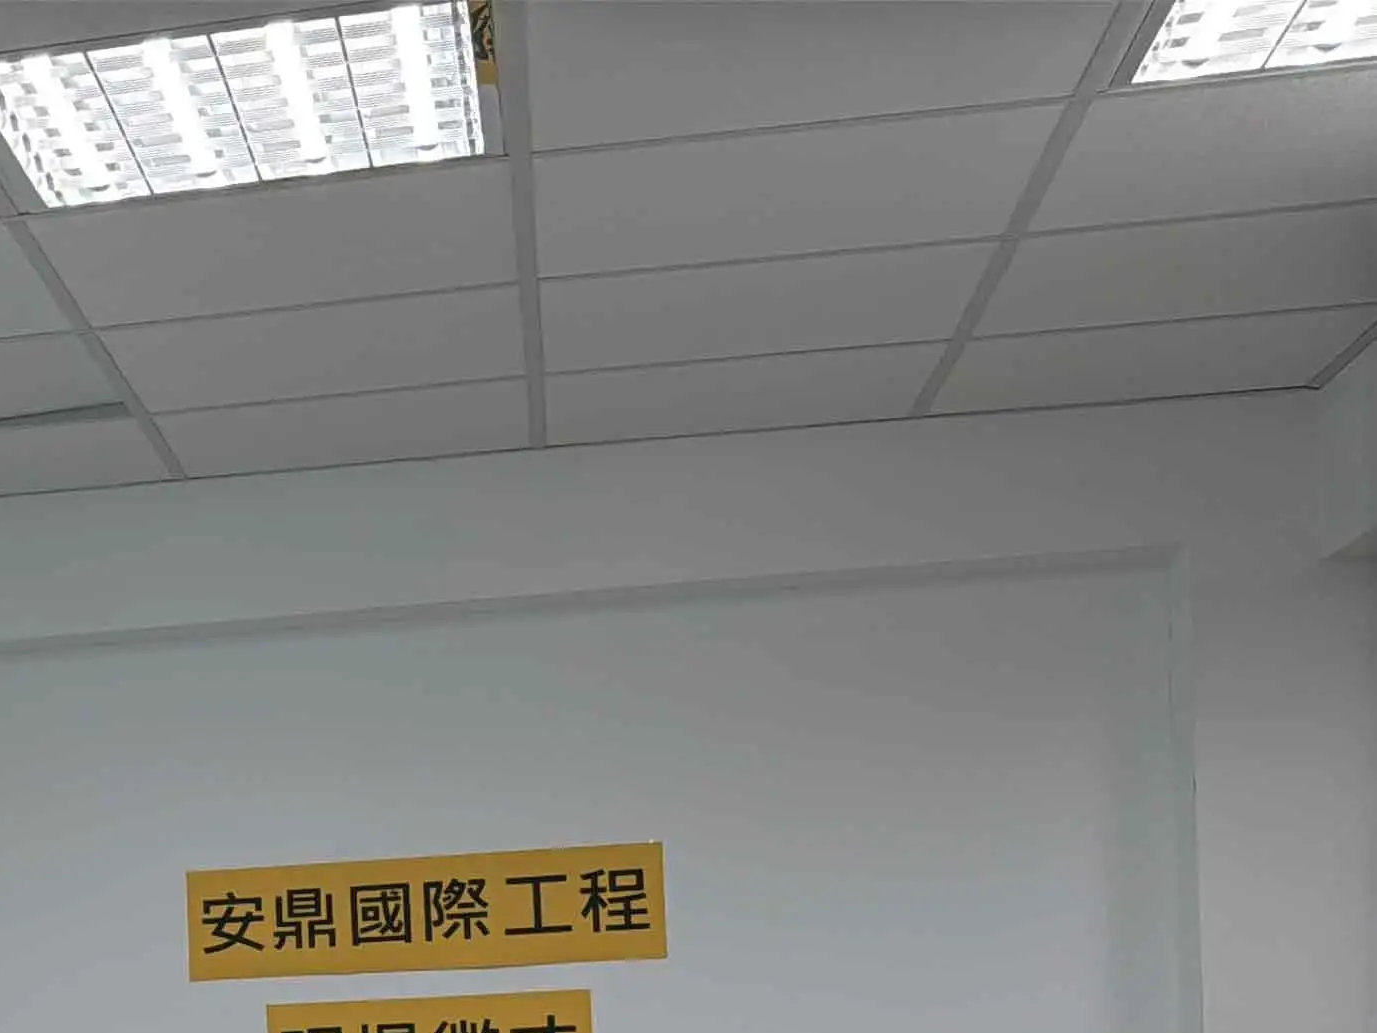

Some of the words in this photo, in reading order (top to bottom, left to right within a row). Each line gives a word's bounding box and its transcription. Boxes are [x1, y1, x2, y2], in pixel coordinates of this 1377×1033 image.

[202, 868, 651, 955] 安鼎國際工程
